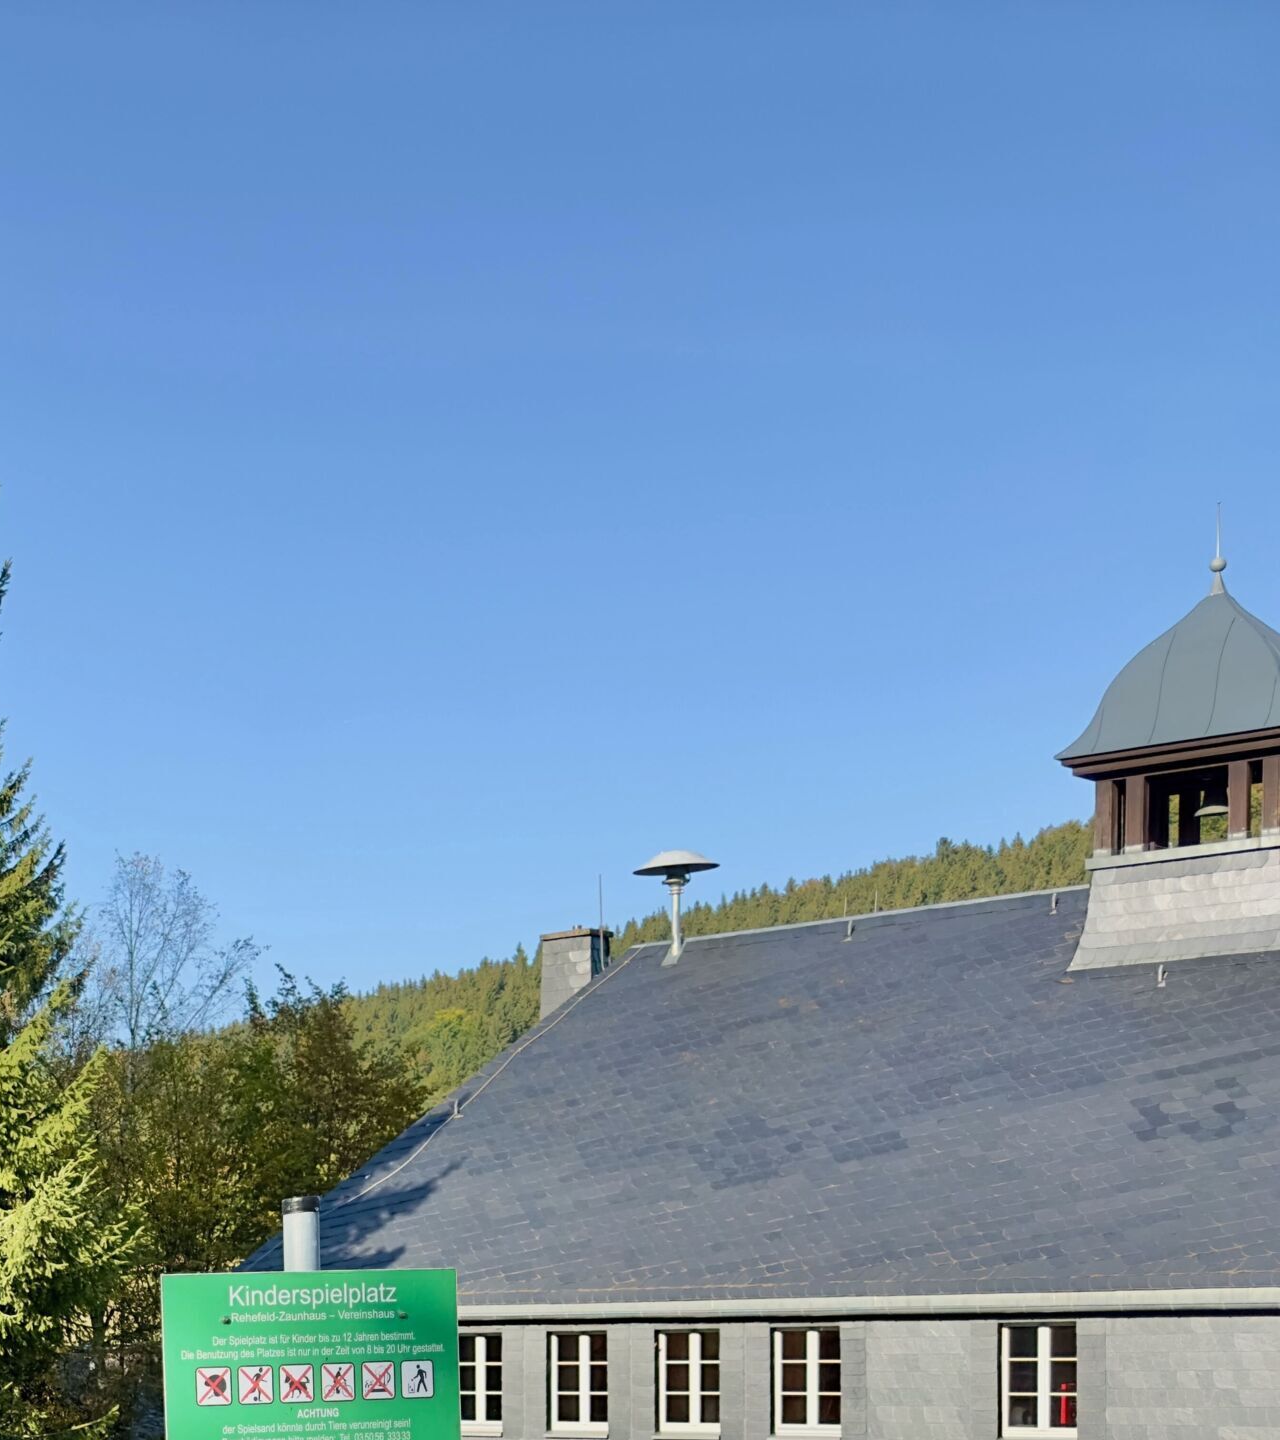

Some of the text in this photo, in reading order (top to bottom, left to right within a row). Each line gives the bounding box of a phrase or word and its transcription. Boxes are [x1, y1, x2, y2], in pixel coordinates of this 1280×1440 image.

[229, 1283, 397, 1310] Kinderspielplatz
[231, 1312, 327, 1323] Rehefeld-Zaunhaus
[338, 1310, 395, 1320] Vereinshaus
[212, 1336, 226, 1346] Der
[229, 1335, 267, 1347] Spielplatz
[269, 1335, 278, 1344] ist
[280, 1334, 290, 1344] für
[292, 1333, 316, 1343] Kinder
[319, 1333, 330, 1342] bis
[344, 1332, 352, 1341] 12
[354, 1331, 379, 1341] Jahren
[381, 1330, 416, 1340] bestimmt.
[181, 1350, 194, 1360] Die
[196, 1349, 239, 1361] Benutzung
[241, 1348, 254, 1358] des
[257, 1347, 285, 1357] Platzes
[287, 1347, 296, 1356] ist
[297, 1348, 310, 1356] nur
[312, 1347, 319, 1355] in
[321, 1346, 334, 1355] der
[336, 1345, 350, 1355] Zeit
[367, 1344, 372, 1354] 8
[374, 1344, 384, 1353] bis
[386, 1344, 396, 1353] 20
[398, 1343, 411, 1353] Uhr
[412, 1342, 444, 1354] gestattet.
[297, 1408, 339, 1418] ACHTUNG
[222, 1418, 411, 1435] der Spielsand könnte durch Tiere verunreinigt sein!
